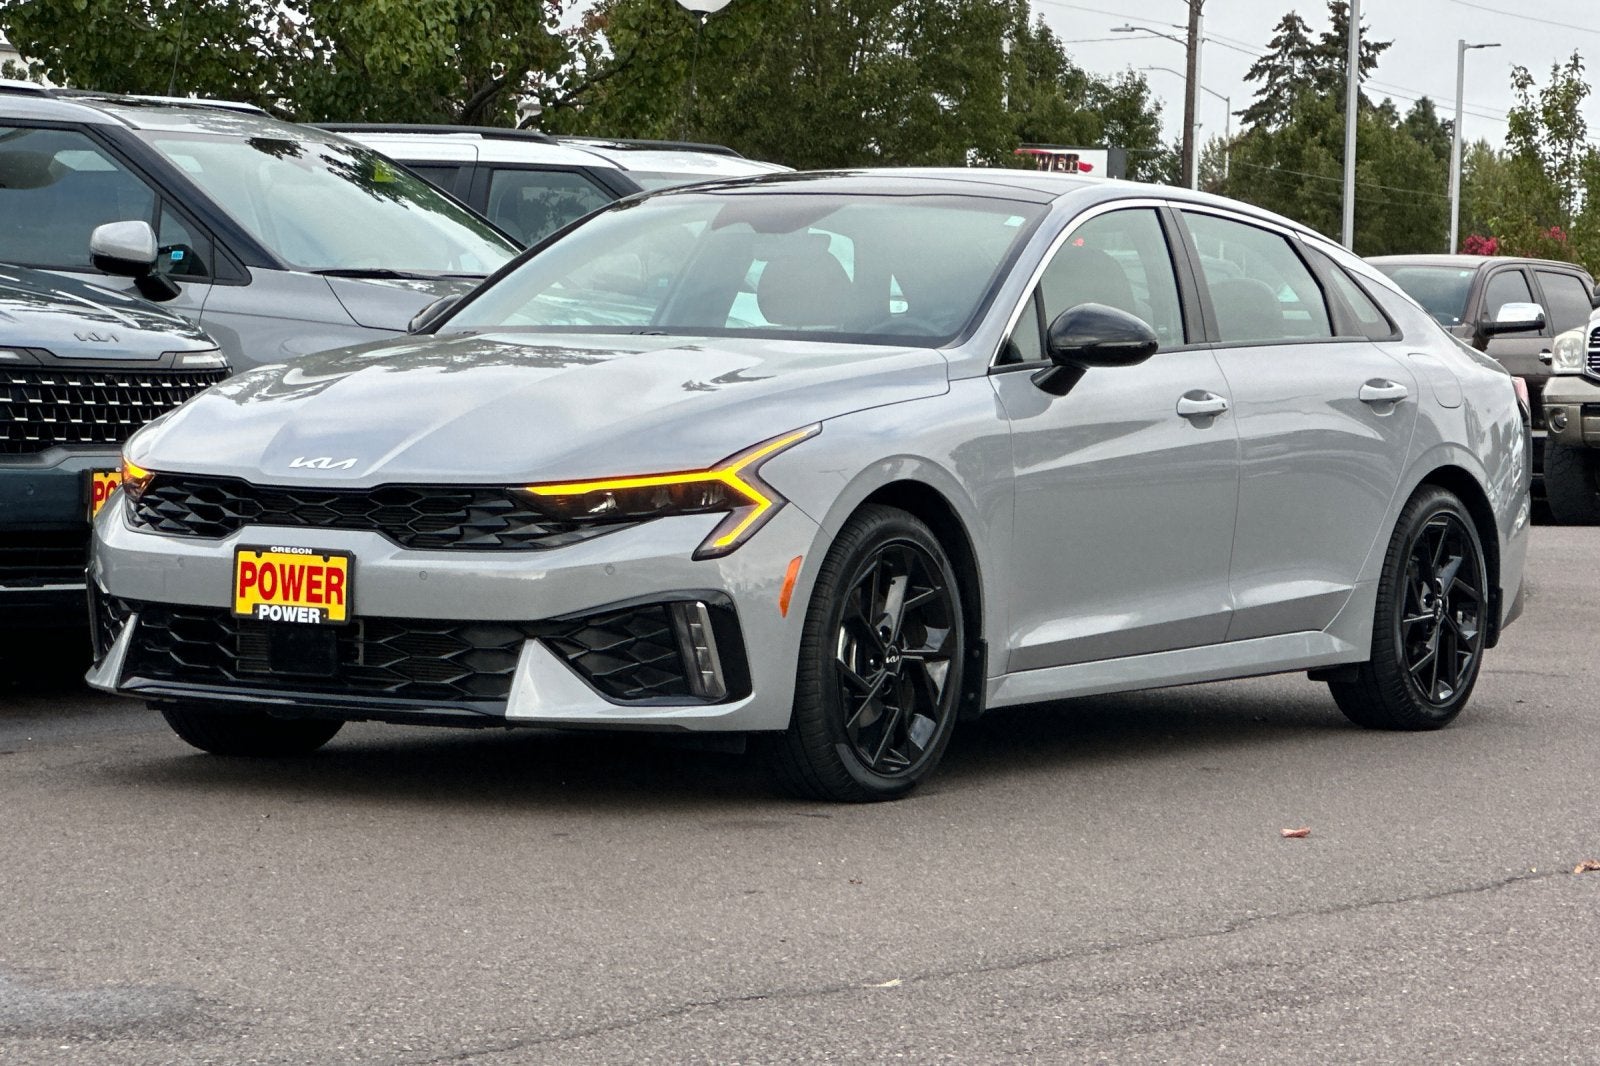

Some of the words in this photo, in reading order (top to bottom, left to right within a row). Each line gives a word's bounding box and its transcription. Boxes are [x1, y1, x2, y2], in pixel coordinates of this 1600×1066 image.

[288, 456, 358, 470] KIA
[270, 546, 313, 555] OREGON
[239, 560, 345, 605] POWER
[258, 604, 321, 624] POWER
